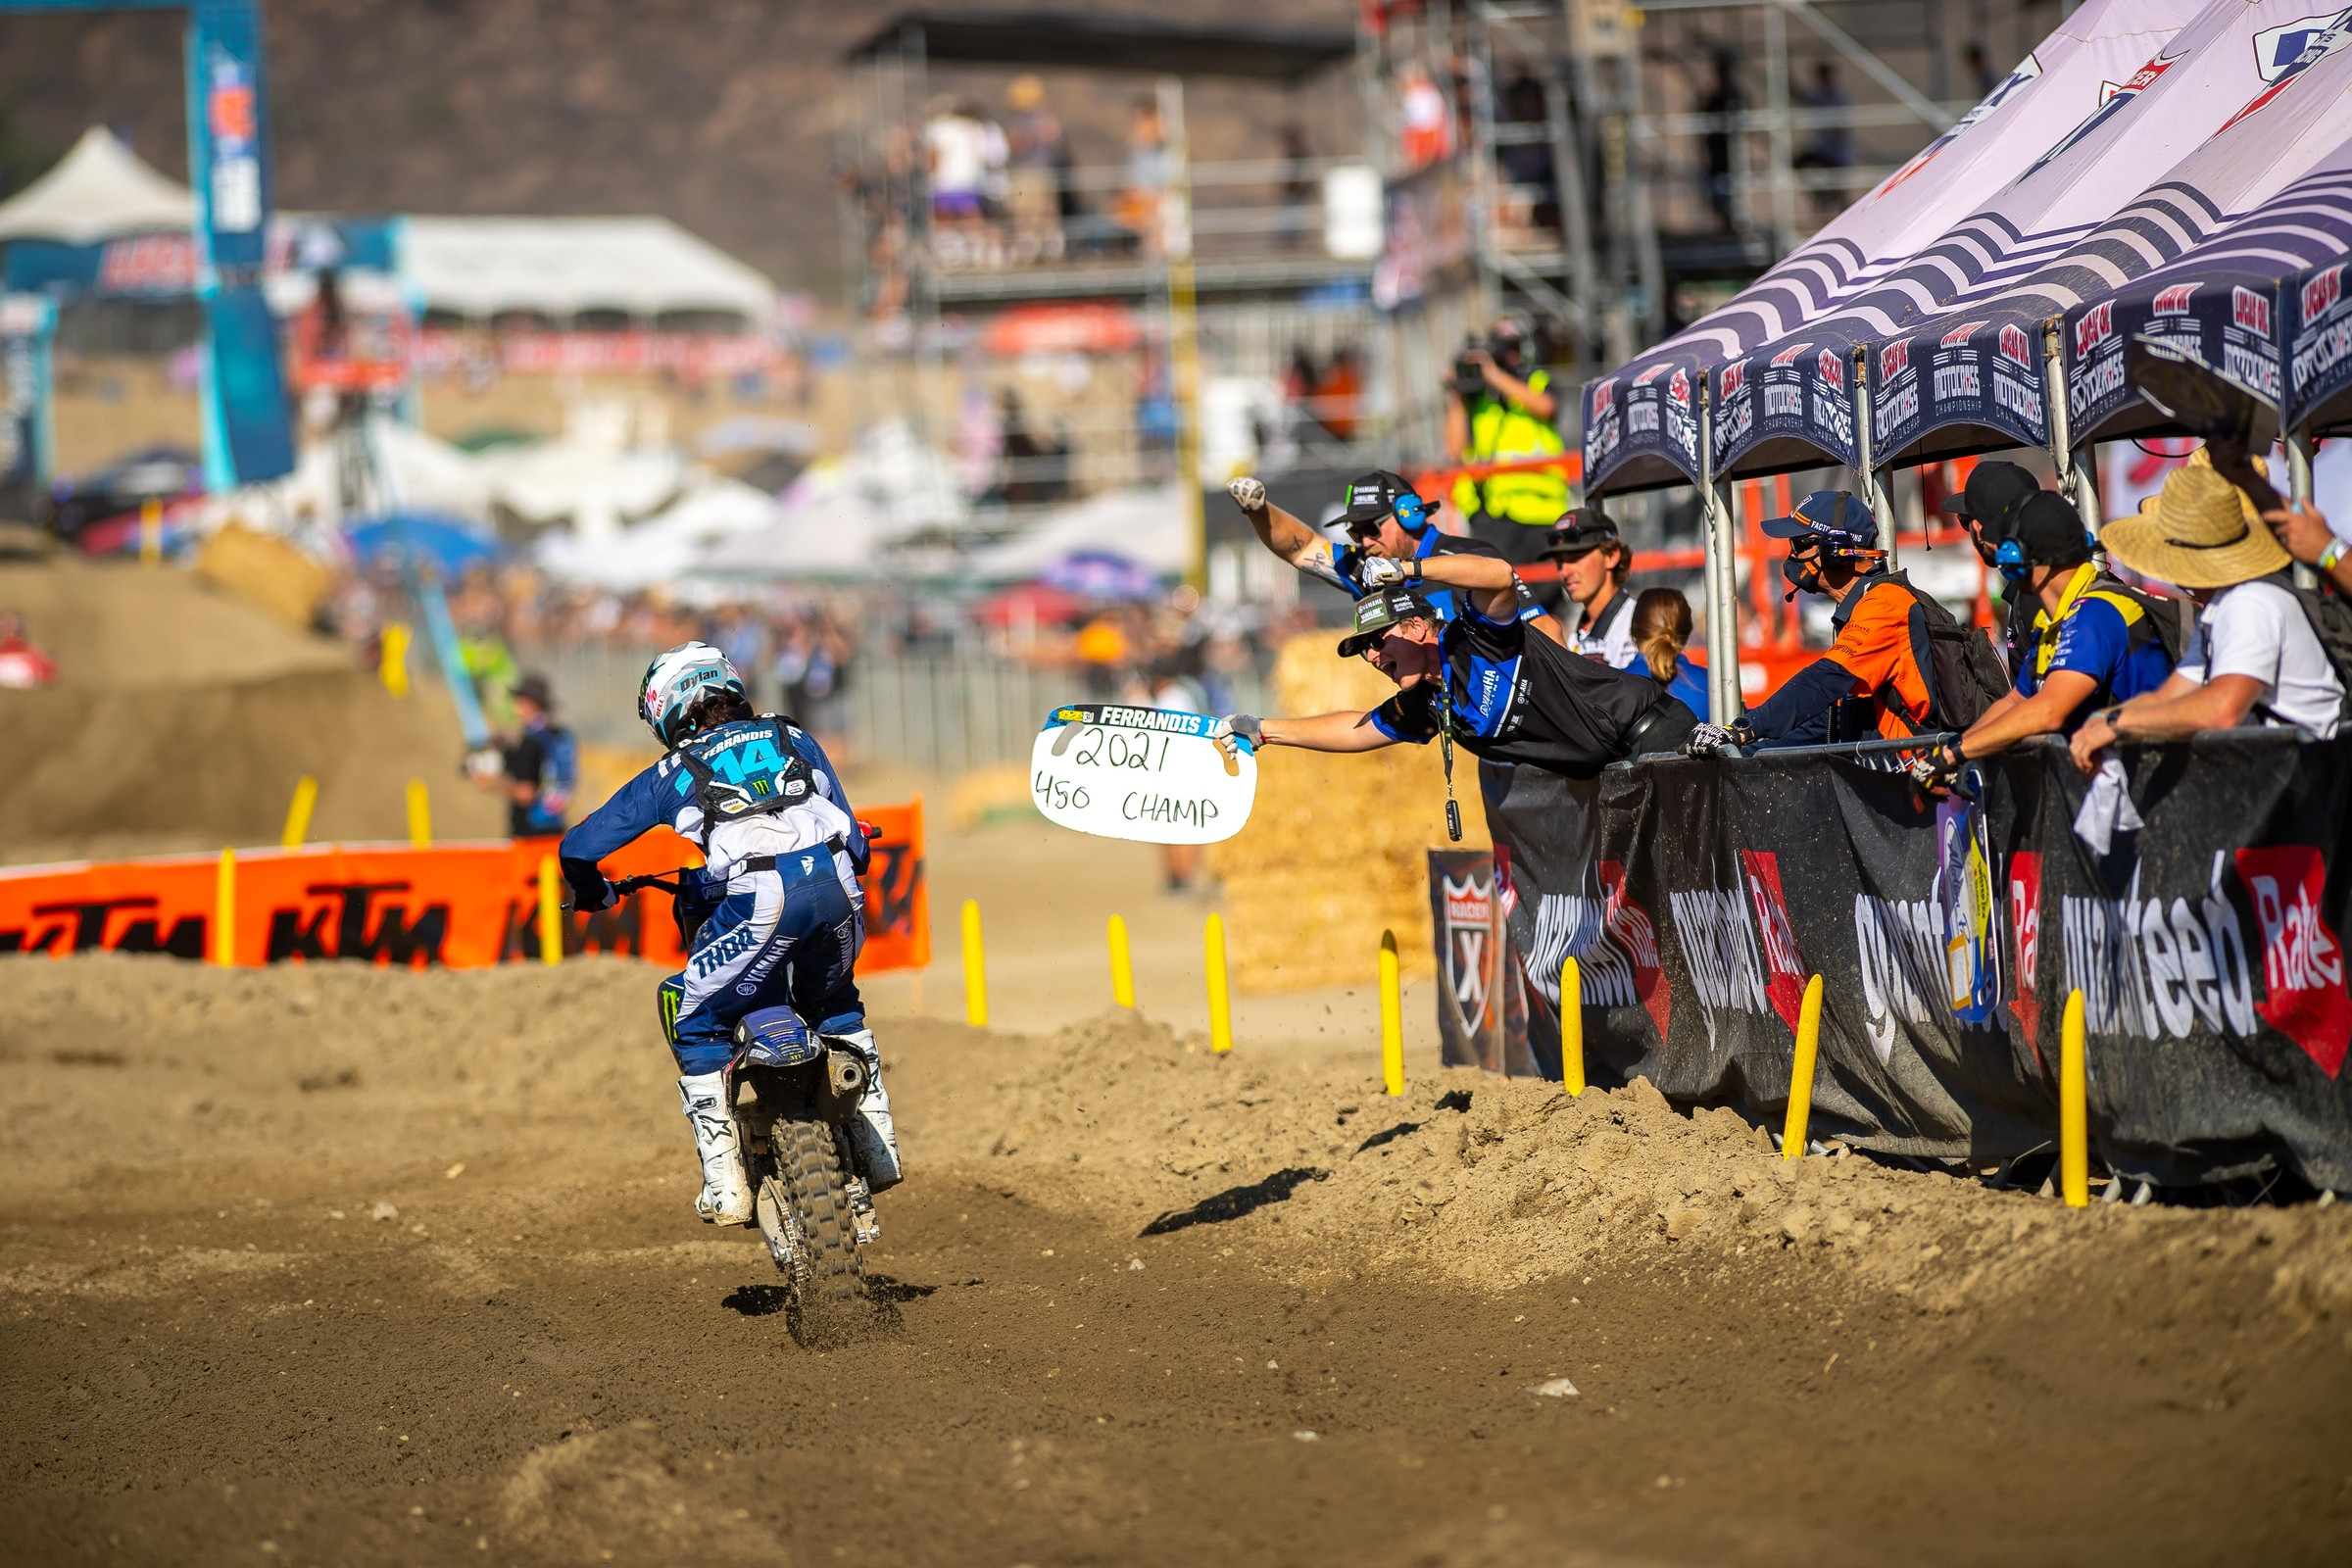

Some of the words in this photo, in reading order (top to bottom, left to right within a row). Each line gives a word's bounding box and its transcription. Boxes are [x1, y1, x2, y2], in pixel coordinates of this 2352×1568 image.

[1765, 384, 1802, 416] MOTOCROSS
[1934, 365, 1981, 402] MOTOCROSS
[1993, 371, 2043, 425] MOTOCROSS
[1876, 381, 1919, 442] MOTOCROSS
[1936, 400, 1982, 416] CHAMPIONSHIP
[679, 669, 718, 694] Dylan
[656, 699, 664, 718] BELL
[1099, 706, 1201, 735] FERRANDIS
[702, 729, 774, 761] FERRANDIS
[710, 738, 788, 785] 14
[1076, 727, 1170, 772] 2021
[1035, 770, 1091, 809] 450
[1122, 791, 1219, 829] CHAMP
[266, 883, 450, 963] KTM
[1449, 902, 1490, 920] RACER
[2250, 875, 2342, 991] Rate
[693, 924, 760, 980] THOR
[745, 938, 792, 983] YAMAHA
[1458, 931, 1484, 1004] X
